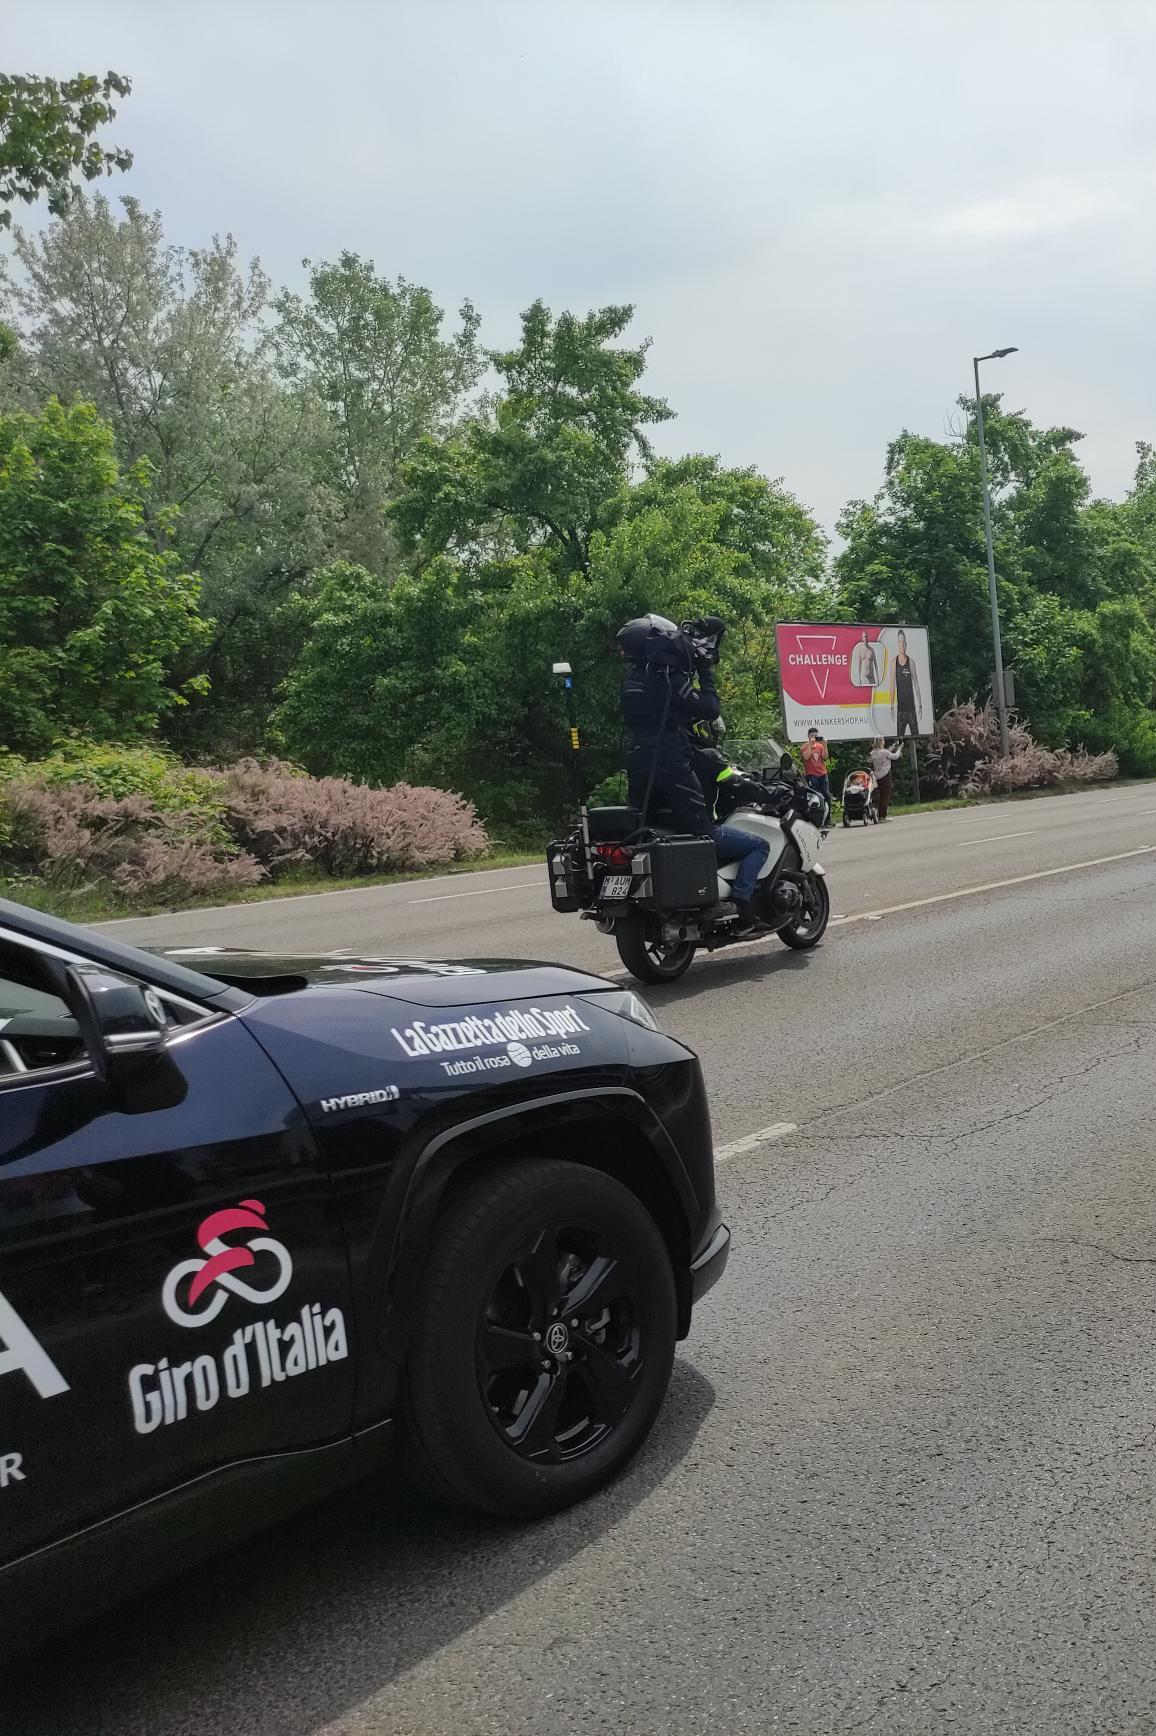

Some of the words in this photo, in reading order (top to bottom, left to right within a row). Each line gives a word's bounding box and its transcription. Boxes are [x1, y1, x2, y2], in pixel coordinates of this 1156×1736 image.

[788, 654, 848, 666] CHALLENGE
[793, 717, 869, 727] WWW.MANKERSHOP.HU
[611, 886, 628, 896] 824
[532, 1043, 561, 1061] della
[560, 1042, 581, 1056] vita
[320, 1089, 388, 1112] HYBRID
[129, 1357, 220, 1435] Giro
[223, 1303, 349, 1399] d'Italia
